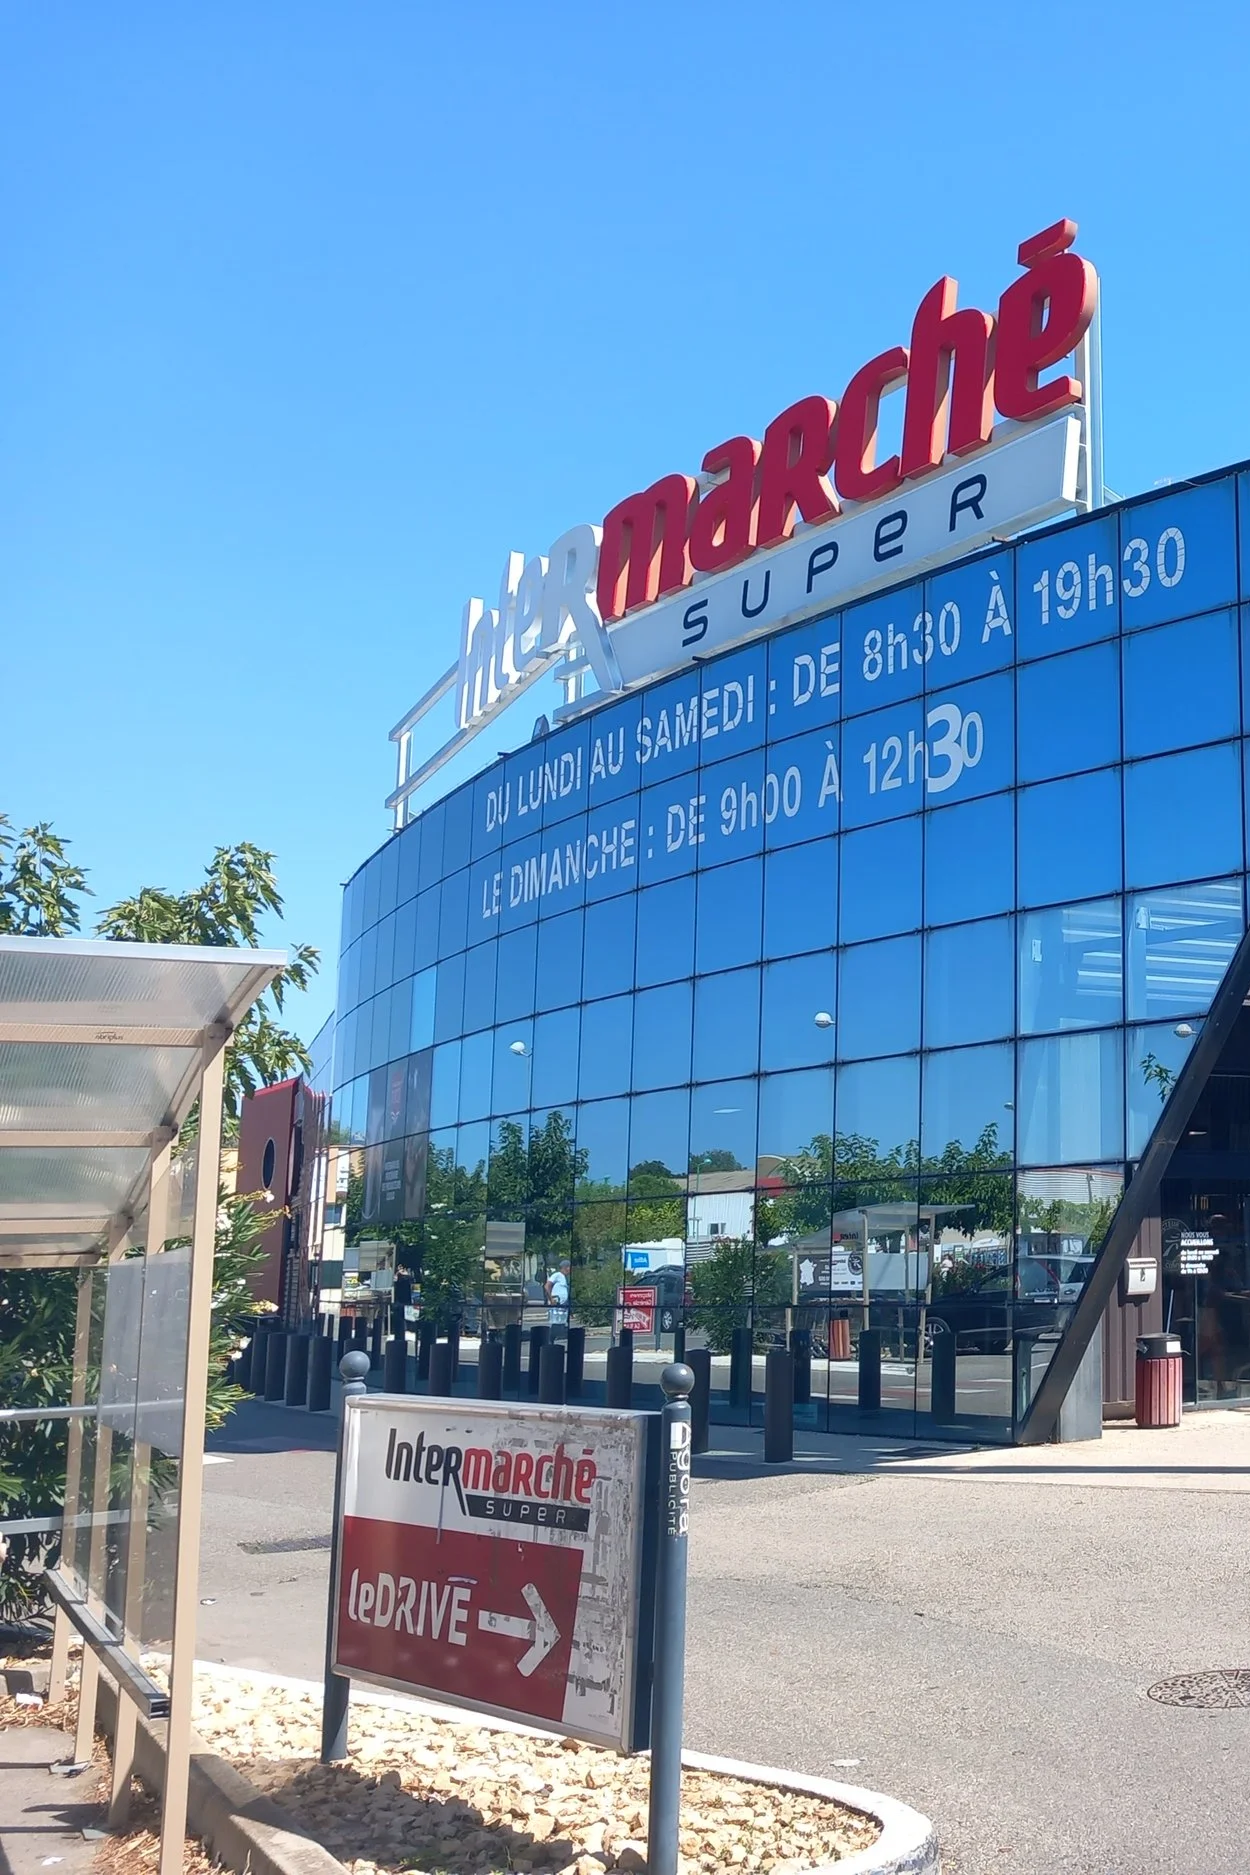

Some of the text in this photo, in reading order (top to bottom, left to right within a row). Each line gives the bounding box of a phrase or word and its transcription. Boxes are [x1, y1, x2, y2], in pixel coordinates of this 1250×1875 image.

[681, 473, 989, 648] SUPER
[486, 782, 511, 833] DU
[517, 747, 582, 816] LUNDI
[589, 727, 625, 786] AU
[635, 675, 754, 765] SAMEDI
[793, 640, 841, 707] DE
[863, 601, 961, 682] 8h30
[981, 570, 1013, 645] À
[1033, 526, 1187, 626] 19h30
[482, 871, 503, 919] LE
[510, 819, 636, 908] DIMANCHE
[666, 795, 706, 853] DE
[720, 765, 802, 836] 9h00
[817, 740, 844, 808] À
[862, 703, 984, 794] 12h30
[485, 1499, 567, 1525] SUPER
